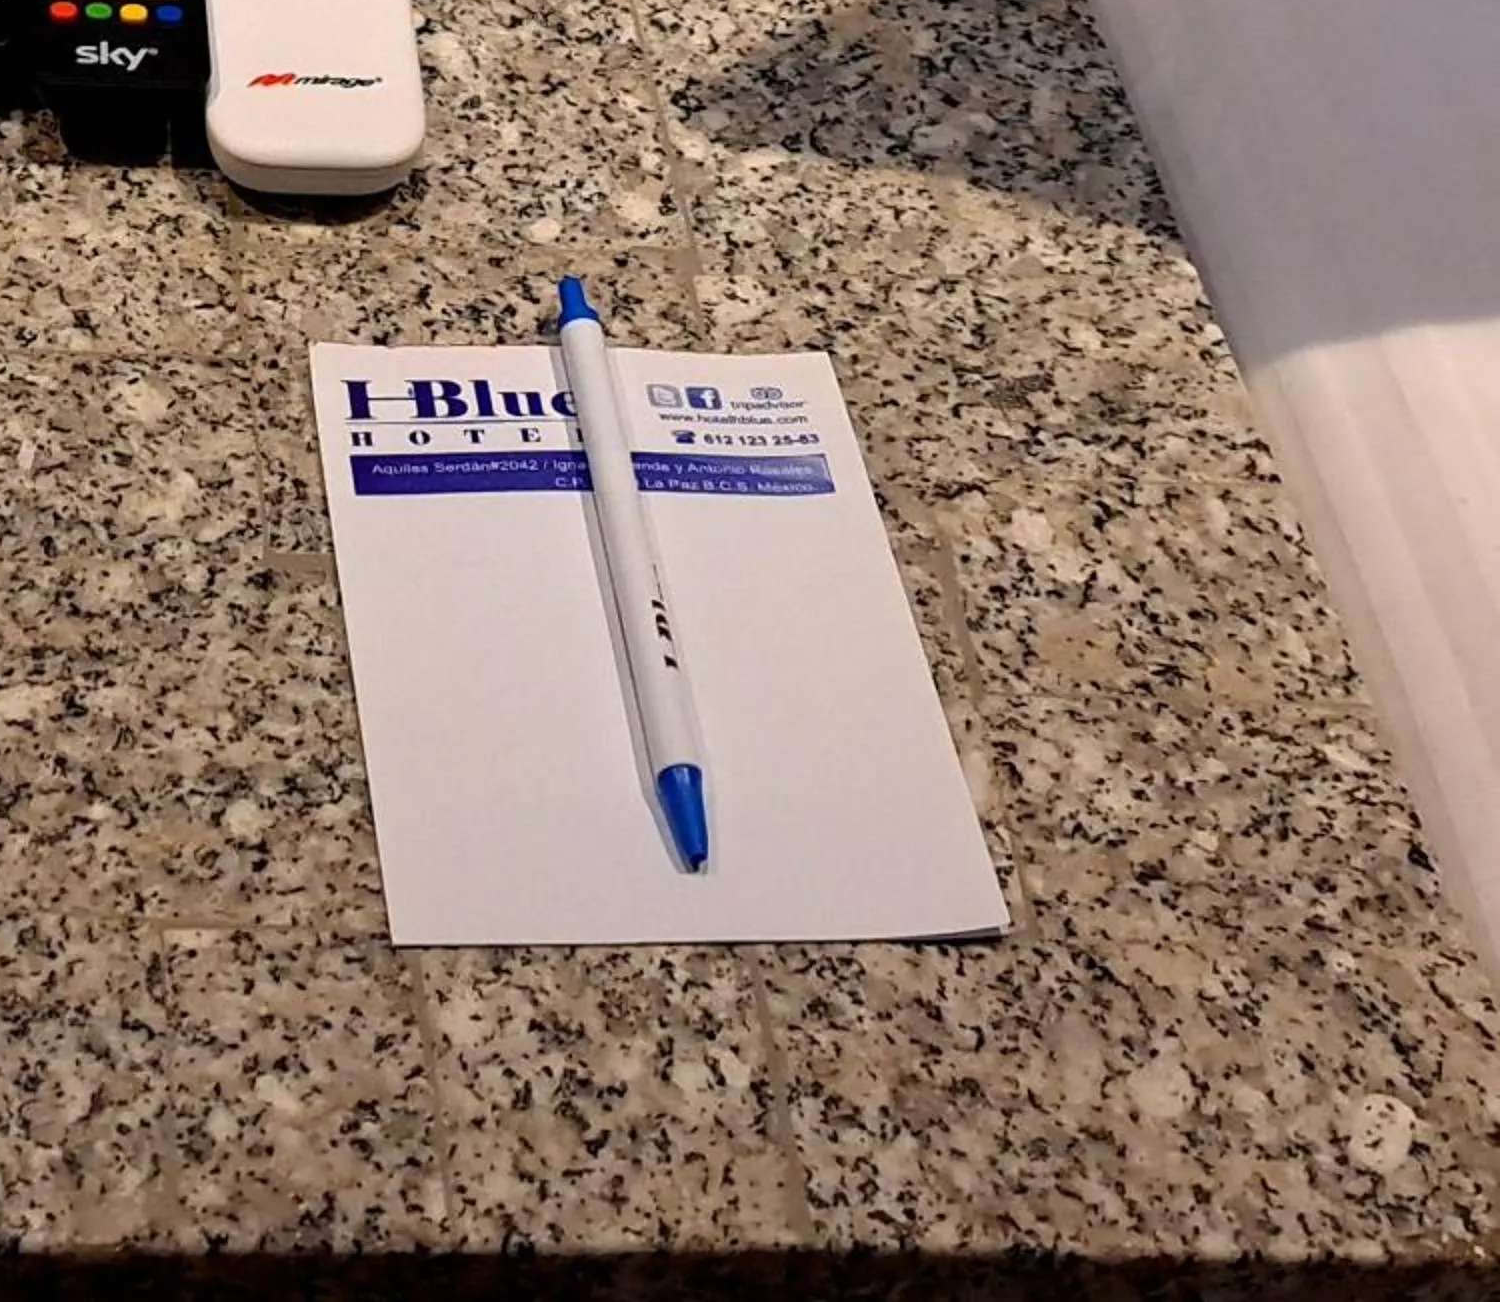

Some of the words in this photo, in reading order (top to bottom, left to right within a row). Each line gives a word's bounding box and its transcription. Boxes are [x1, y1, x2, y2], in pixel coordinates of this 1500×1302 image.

[74, 40, 150, 71] sky
[294, 73, 375, 88] mirage
[703, 433, 733, 445] 612
[738, 435, 768, 447] 123
[371, 463, 429, 475] Aquiles
[553, 458, 587, 473] Igna
[673, 464, 683, 475] y
[645, 478, 665, 489] La
